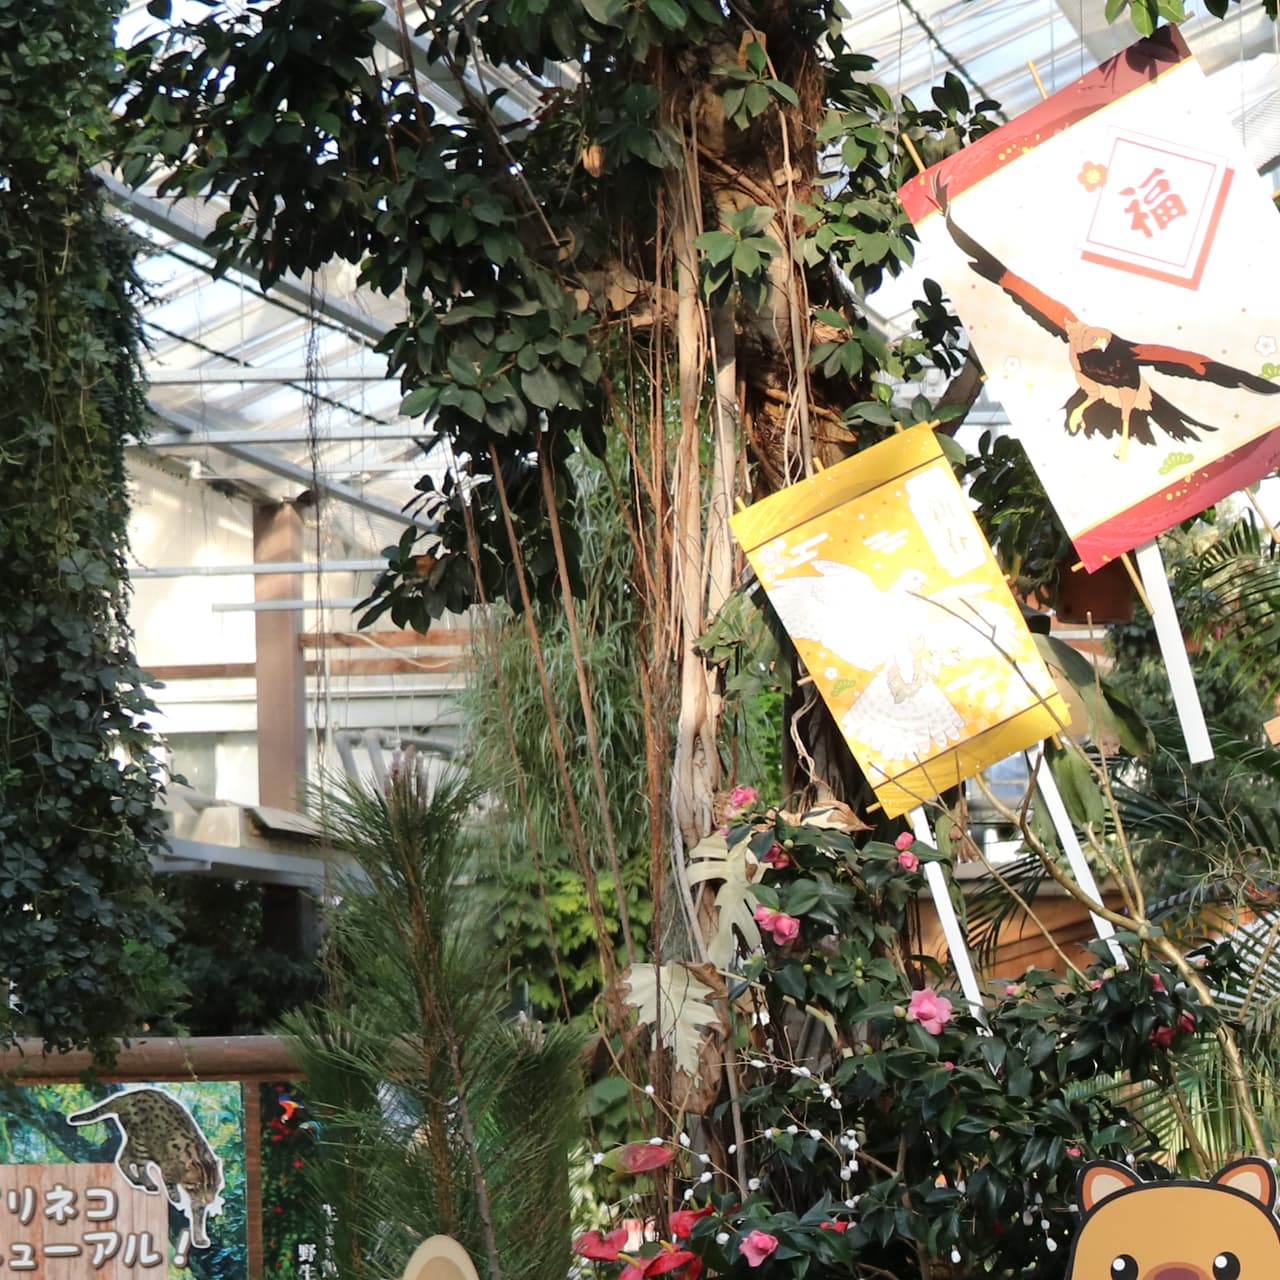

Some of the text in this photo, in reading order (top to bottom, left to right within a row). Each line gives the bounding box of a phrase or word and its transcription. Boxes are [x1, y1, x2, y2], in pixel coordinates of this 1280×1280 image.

[1119, 168, 1188, 239] 福
[0, 1183, 119, 1225] リネコ
[0, 1229, 191, 1271] ューアル！
